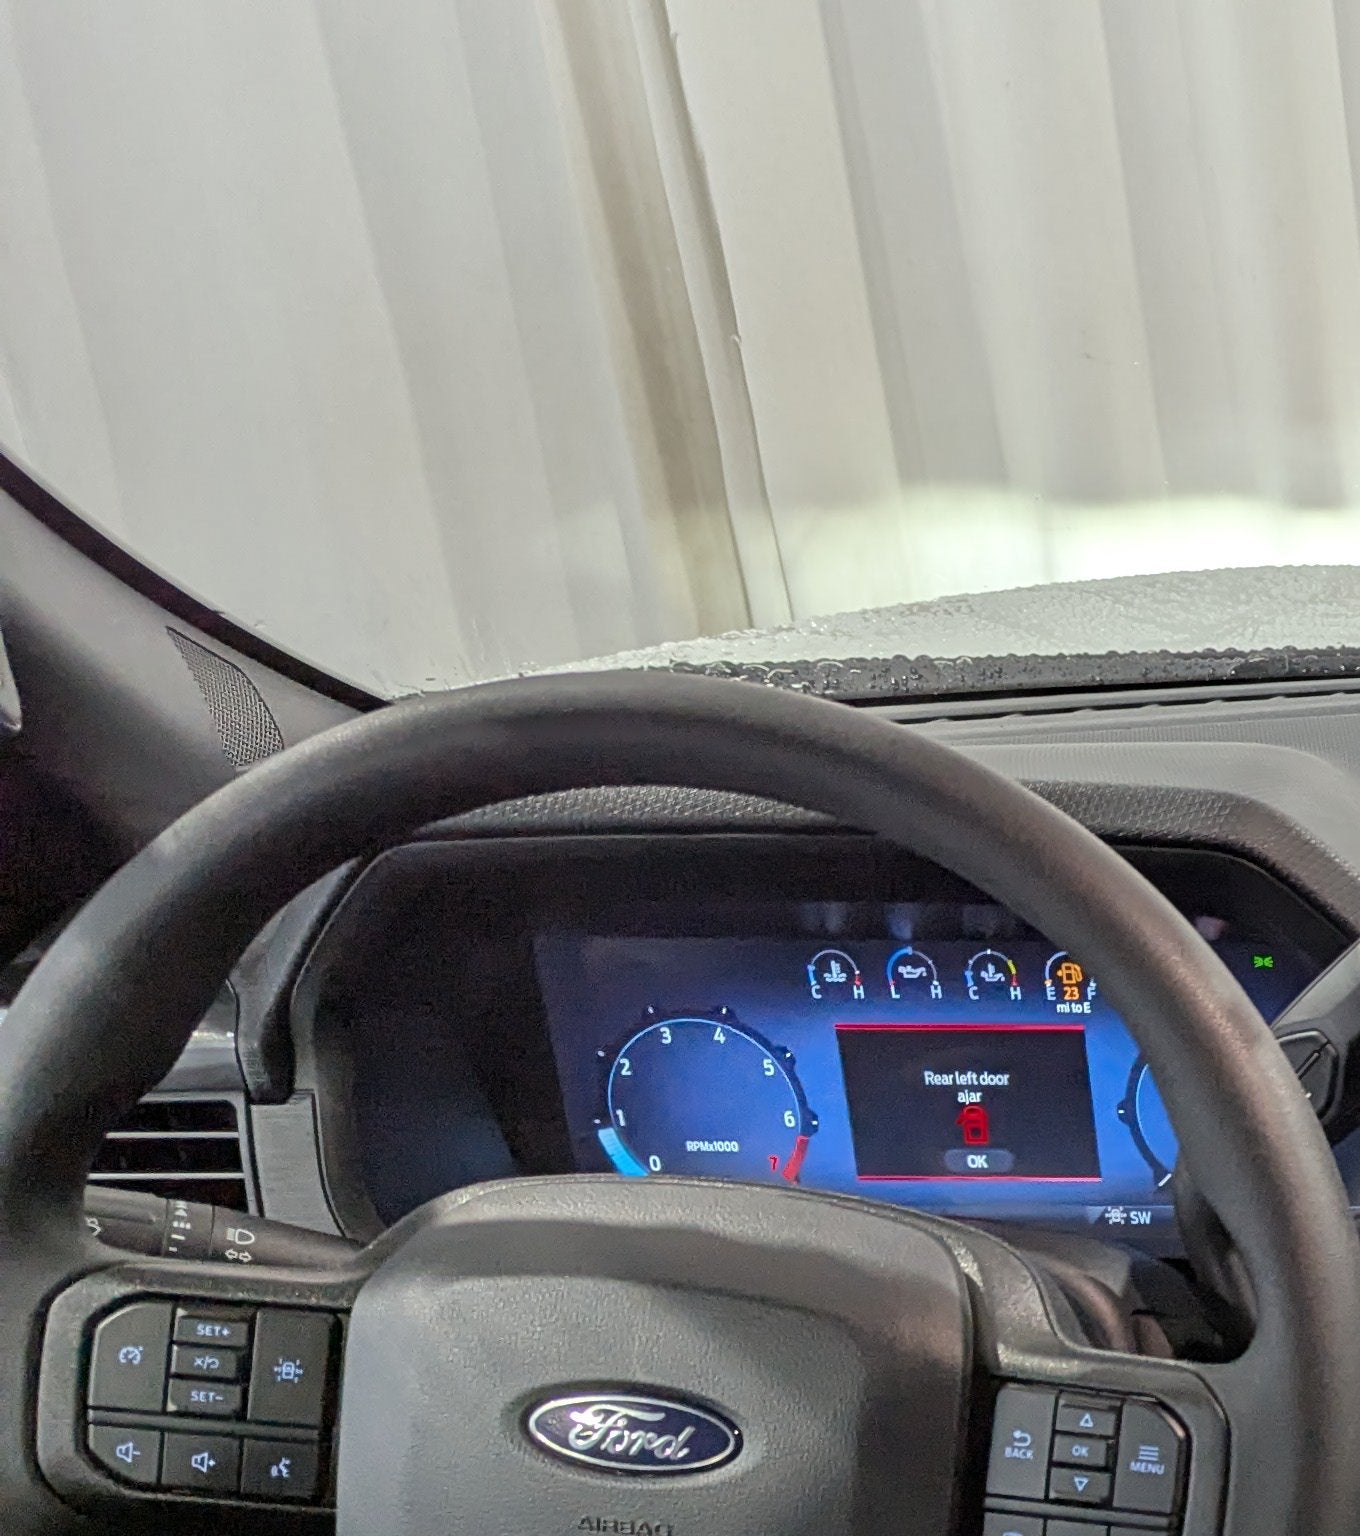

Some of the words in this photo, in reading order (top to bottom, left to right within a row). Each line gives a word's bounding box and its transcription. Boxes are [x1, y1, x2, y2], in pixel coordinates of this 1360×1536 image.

[811, 985, 822, 999] C
[853, 985, 865, 999] H
[891, 985, 901, 999] L
[930, 985, 943, 999] H
[969, 986, 980, 1000] C
[1010, 986, 1022, 1000] H
[1046, 986, 1057, 1001] E
[1063, 986, 1080, 1000] 23
[1087, 986, 1097, 1000] F
[1056, 1002, 1071, 1013] mi
[1072, 1002, 1083, 1013] to
[1083, 1002, 1092, 1014] E
[660, 1027, 672, 1044] 3
[713, 1027, 726, 1044] 4
[620, 1059, 632, 1076] 2
[763, 1059, 775, 1076] 5
[924, 1071, 954, 1086] Rear
[955, 1071, 978, 1086] left
[979, 1071, 1010, 1086] door
[957, 1090, 982, 1105] ajar
[616, 1110, 627, 1127] 1
[784, 1111, 796, 1128] 6
[686, 1141, 739, 1153] RPMx1000
[650, 1156, 662, 1172] 0
[769, 1156, 779, 1171] 7
[967, 1155, 988, 1169] OK
[1130, 1211, 1151, 1225] SW
[568, 1403, 696, 1460] Ford
[1004, 1447, 1034, 1460] BACK
[1072, 1445, 1089, 1457] OK
[1129, 1461, 1165, 1475] MENU
